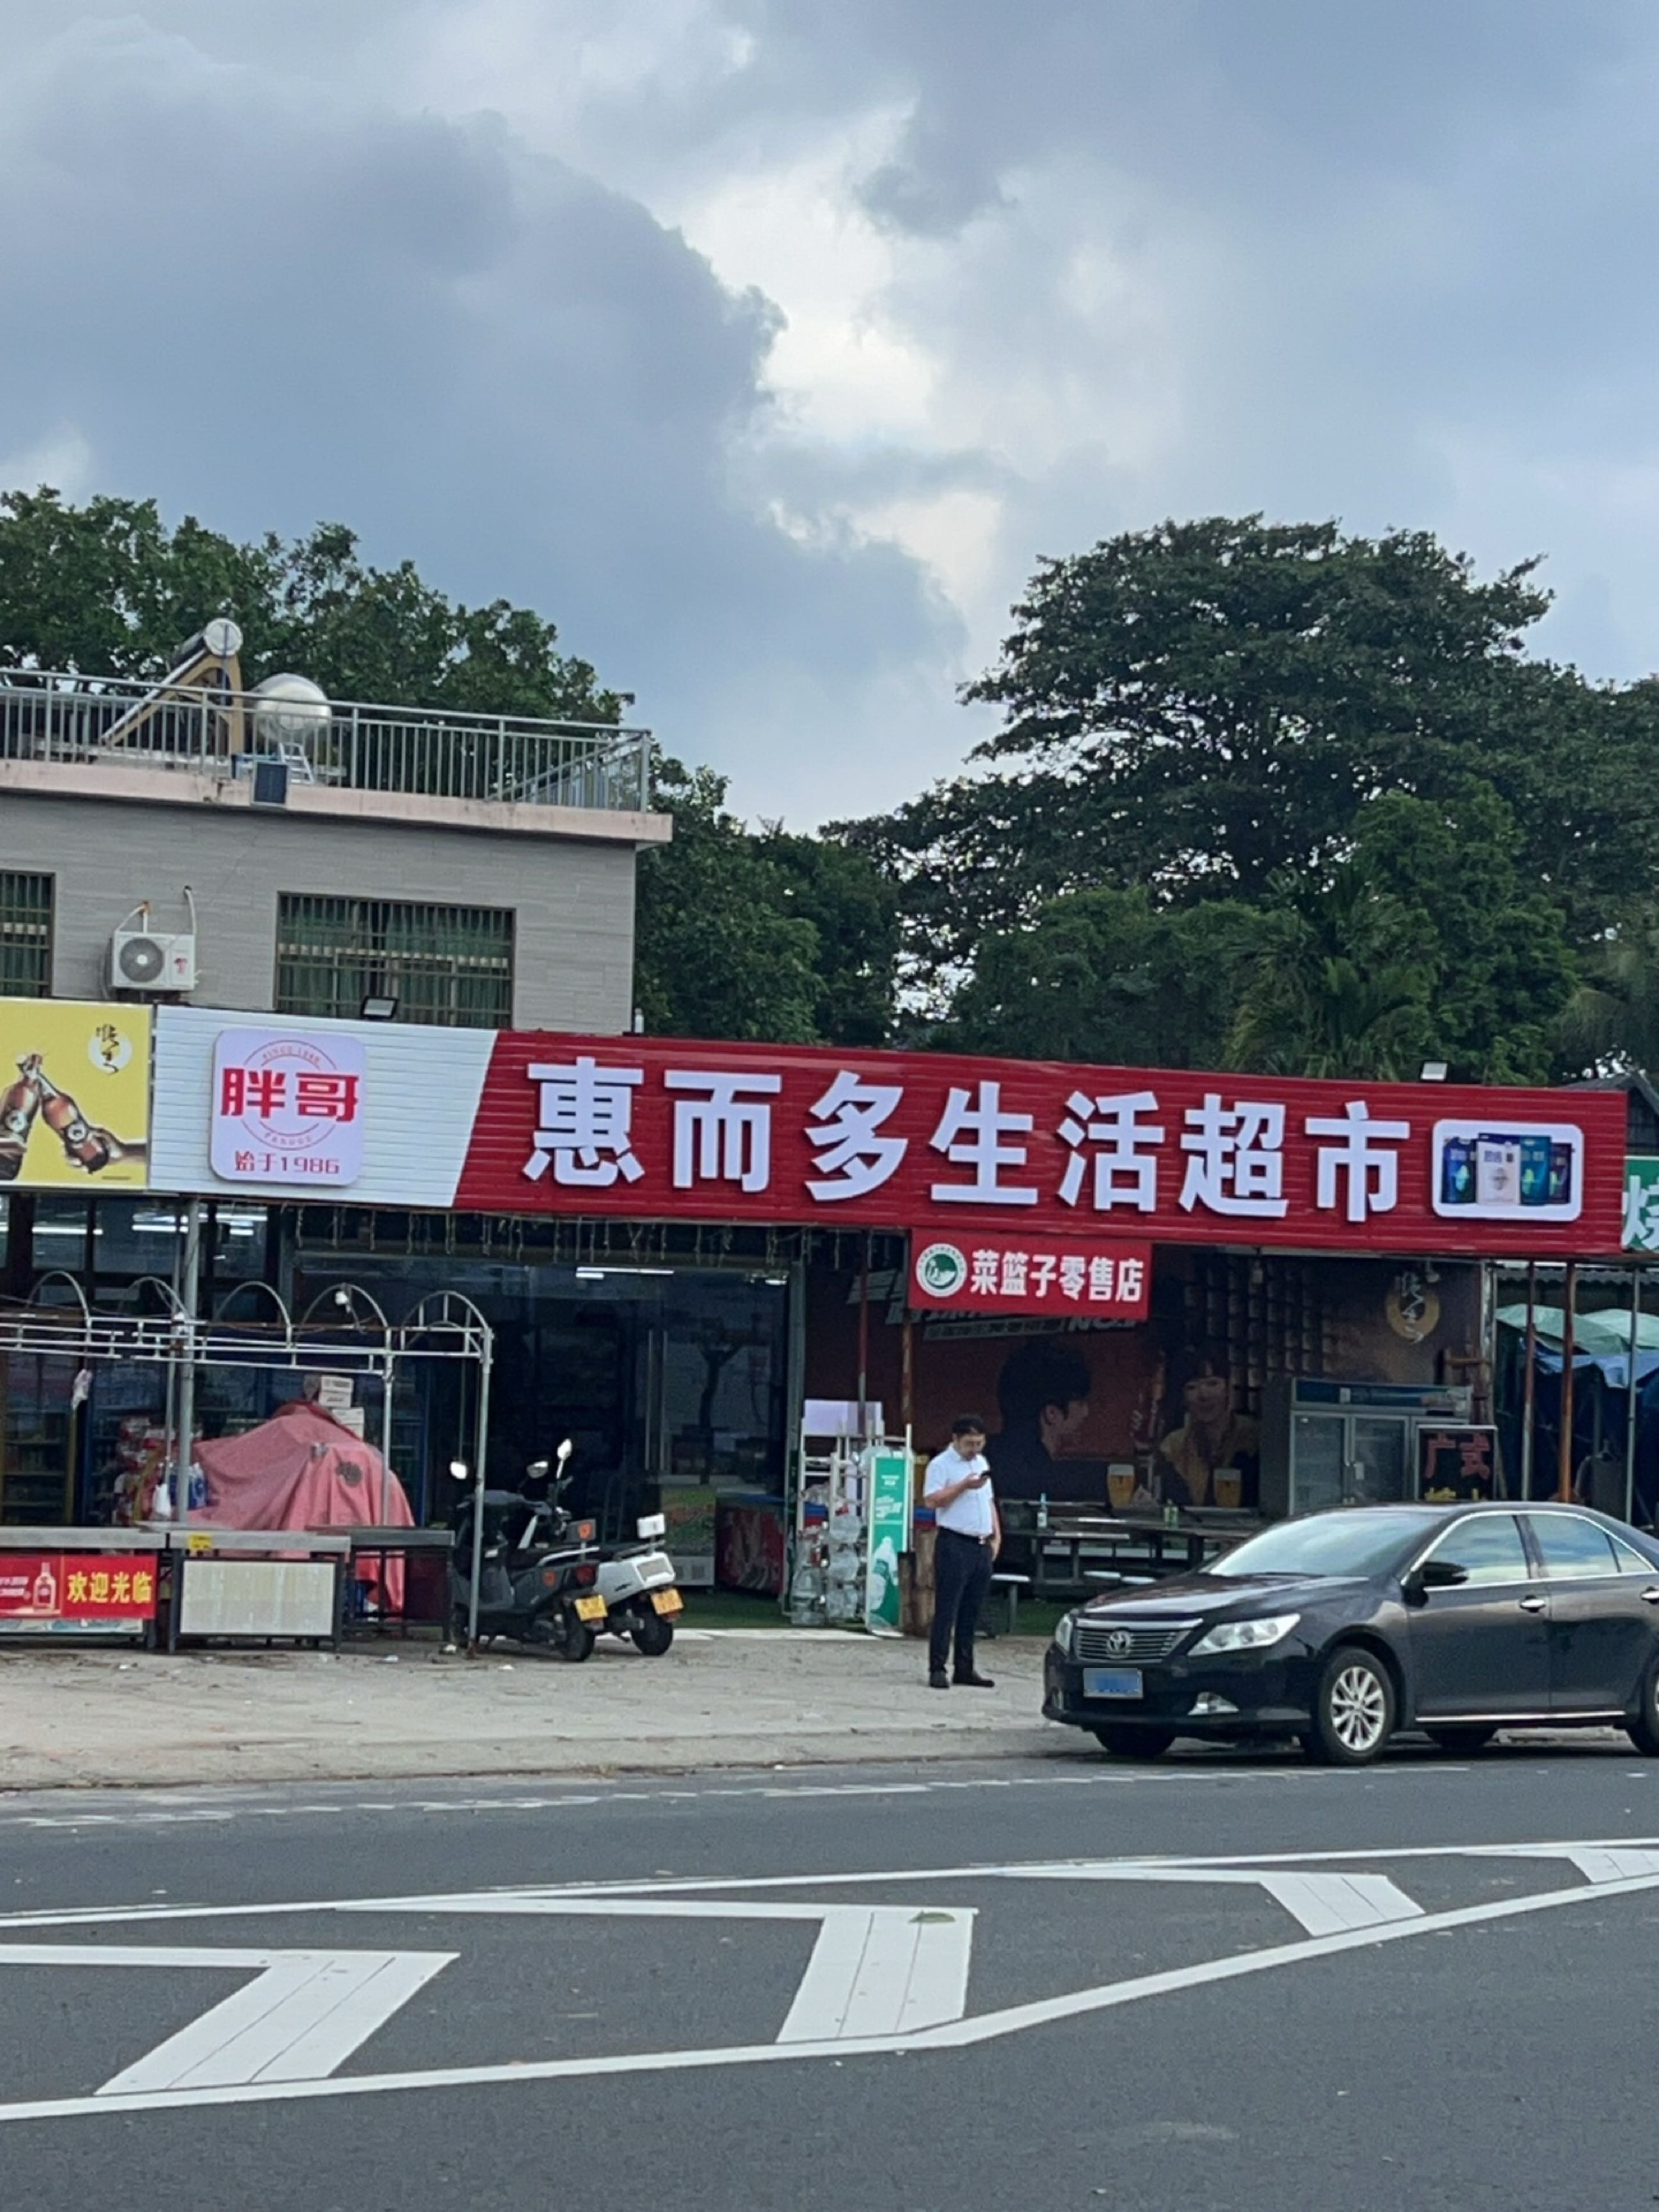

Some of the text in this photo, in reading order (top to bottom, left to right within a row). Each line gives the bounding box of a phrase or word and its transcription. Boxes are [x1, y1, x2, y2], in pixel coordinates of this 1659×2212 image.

[221, 1068, 359, 1122] 胖哥
[235, 1150, 340, 1174] 始于1986
[522, 1056, 1409, 1222] 惠而多生活超市
[970, 1249, 1144, 1302] 菜篮子零售店
[67, 1571, 153, 1605] 欢迎光临
